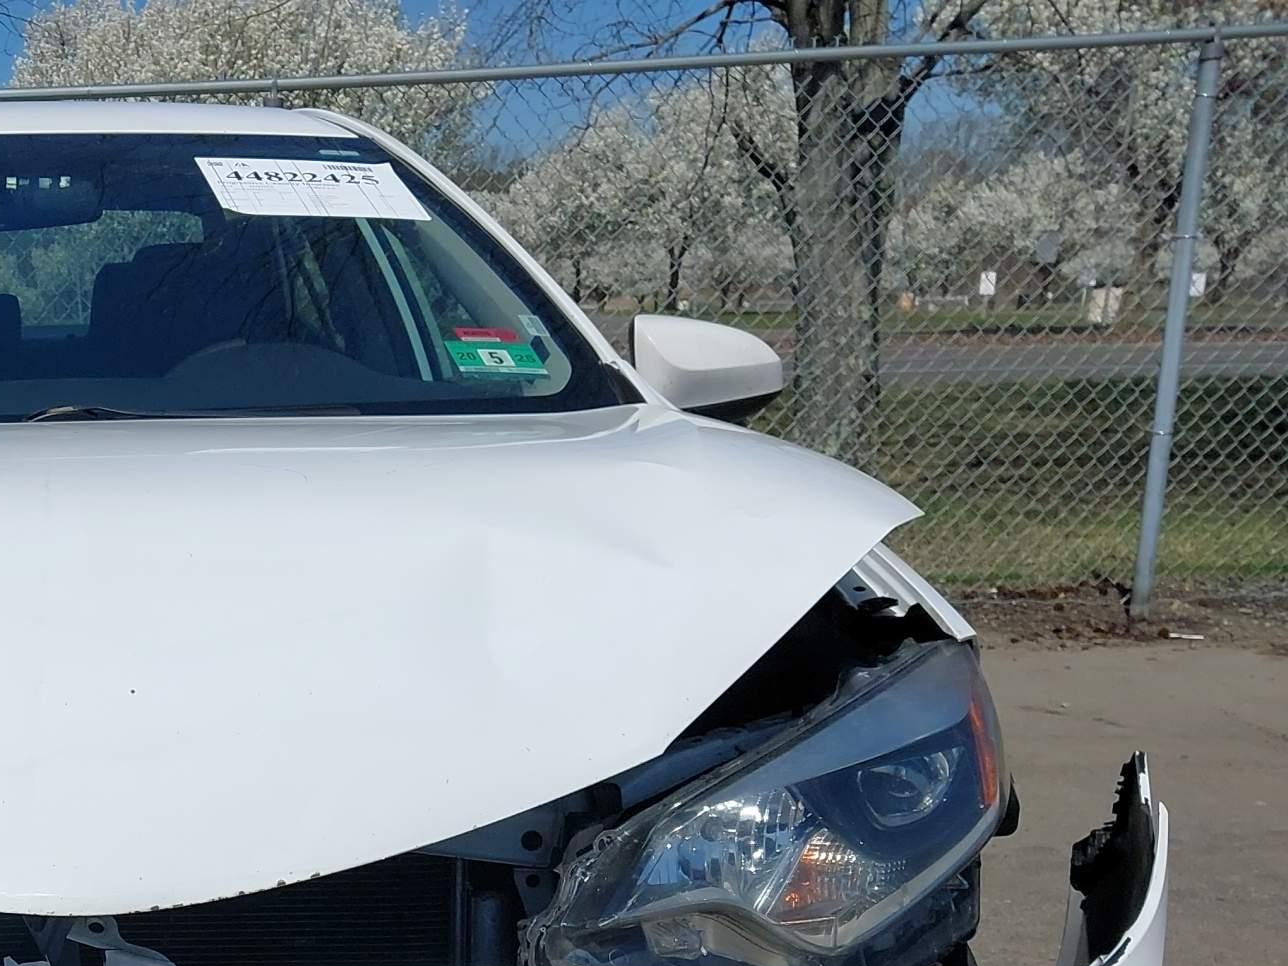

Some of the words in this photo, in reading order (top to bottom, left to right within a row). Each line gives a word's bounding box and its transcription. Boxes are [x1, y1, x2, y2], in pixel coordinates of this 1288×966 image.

[226, 171, 379, 185] 44822425
[456, 352, 477, 361] 20
[488, 352, 505, 365] 5
